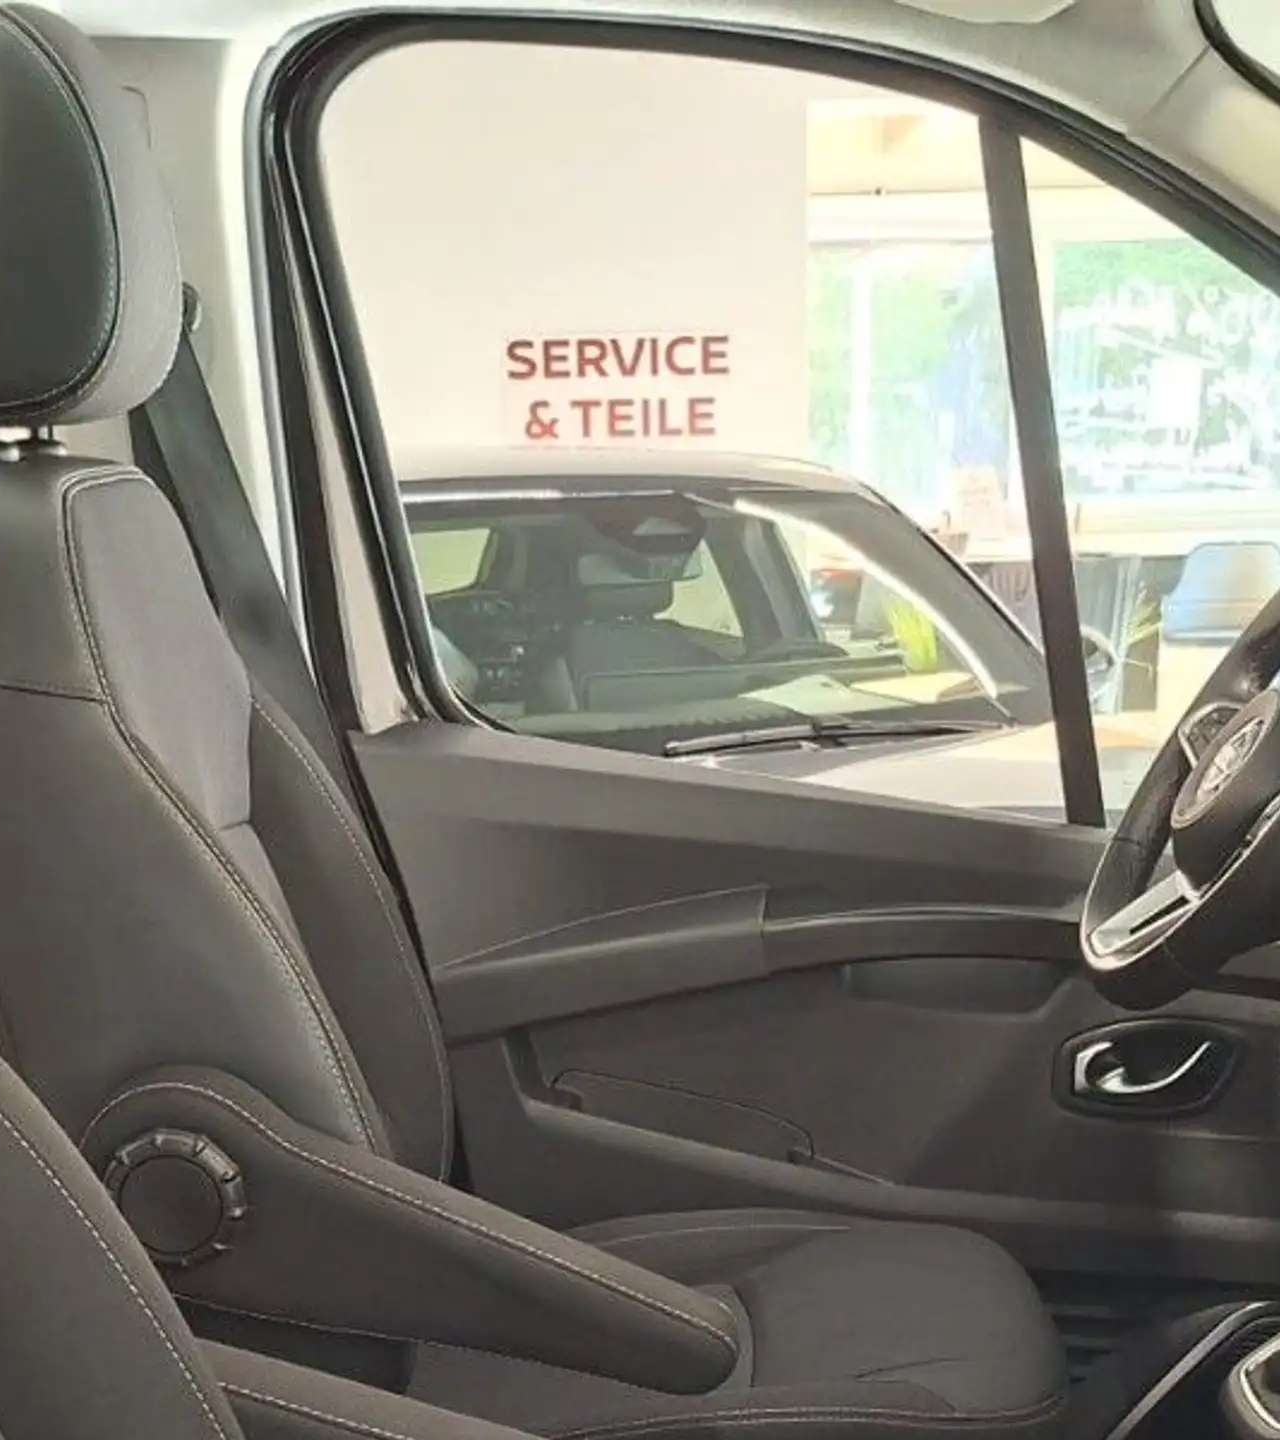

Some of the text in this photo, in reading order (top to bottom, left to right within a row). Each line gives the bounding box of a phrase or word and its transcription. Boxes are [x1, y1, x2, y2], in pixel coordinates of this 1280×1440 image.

[506, 335, 730, 380] SERVICE
[525, 397, 716, 439] & TEILE
